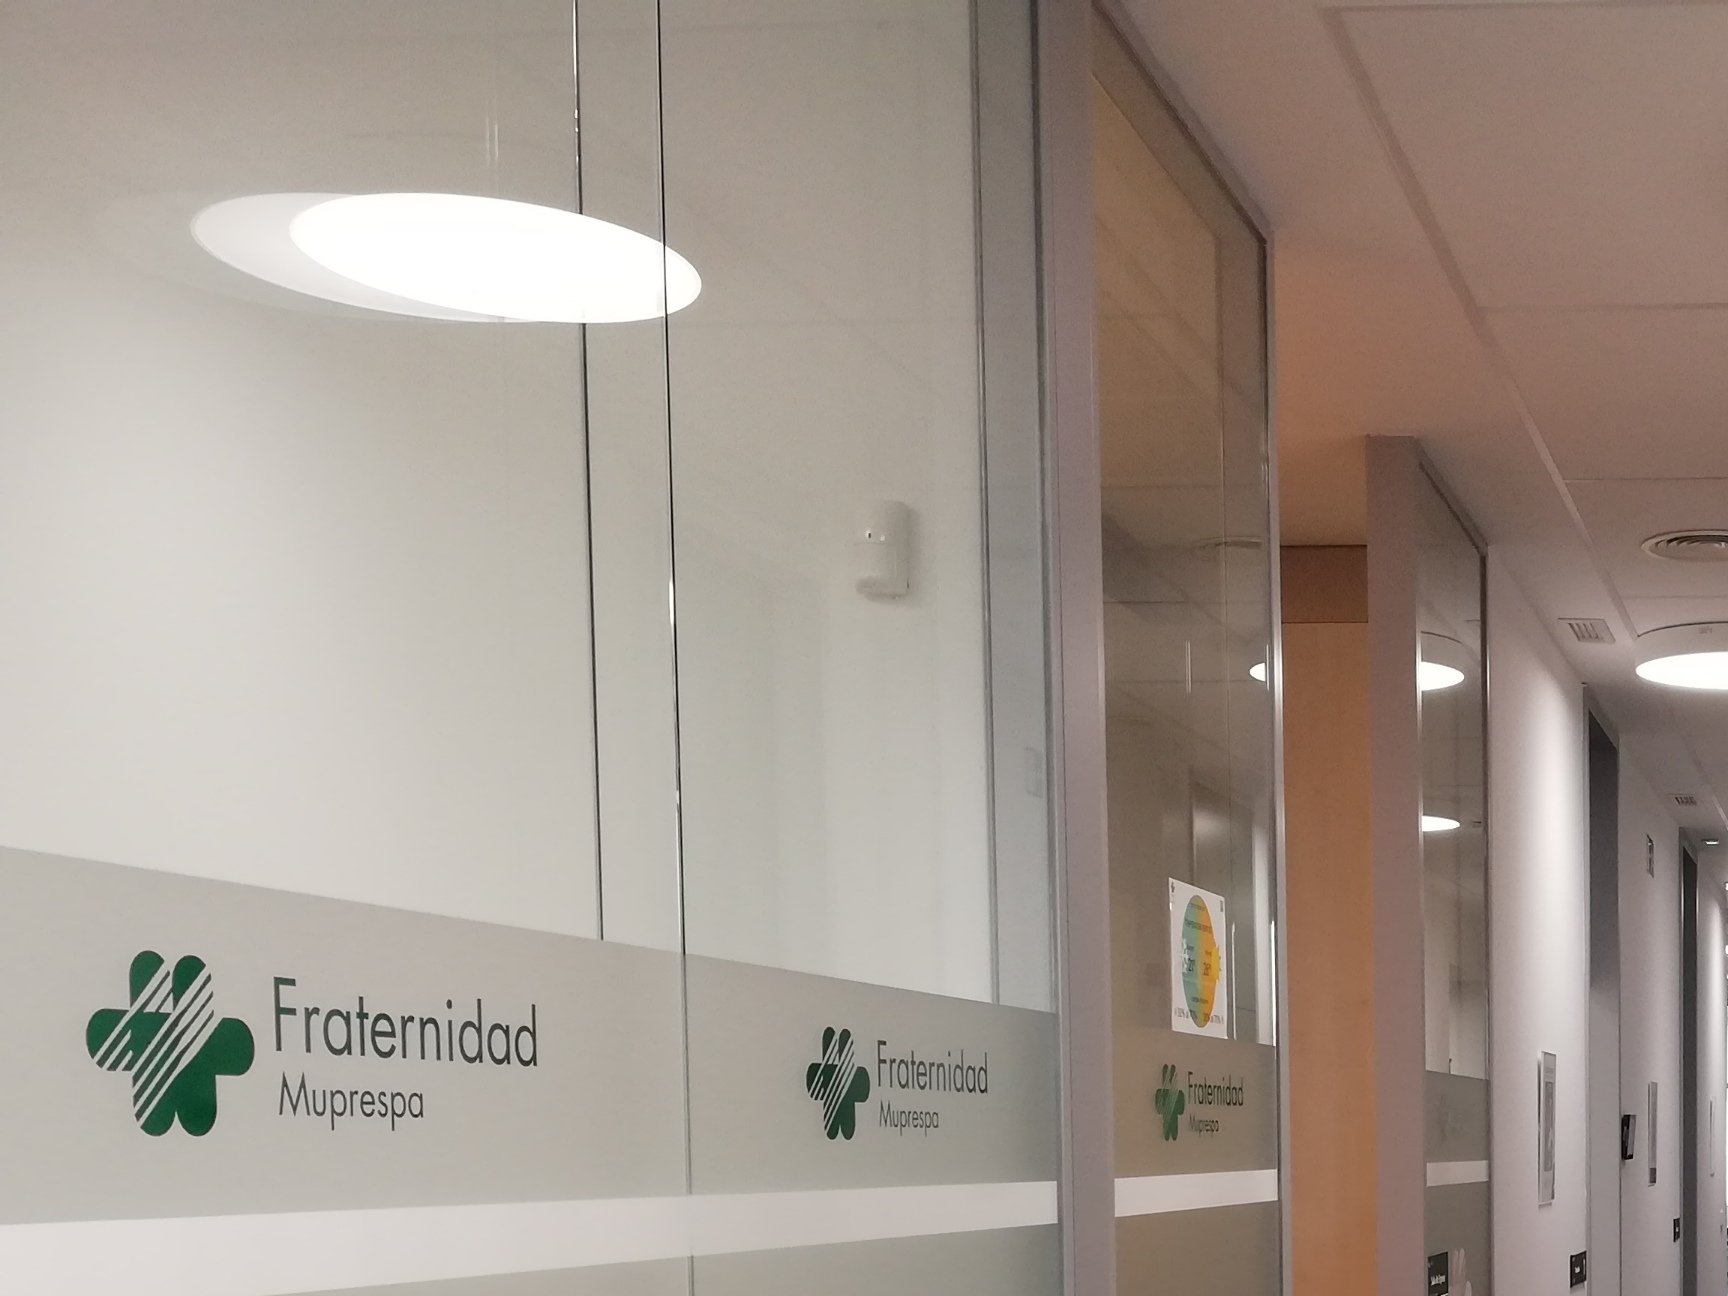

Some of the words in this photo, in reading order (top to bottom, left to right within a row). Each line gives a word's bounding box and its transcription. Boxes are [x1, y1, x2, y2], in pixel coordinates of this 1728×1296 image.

[272, 975, 539, 1068] Fraternidad
[877, 1040, 988, 1094] Fraternidad
[1187, 1071, 1244, 1107] Fraternidad
[278, 1071, 425, 1132] Muprespa
[879, 1099, 940, 1137] Muprespa
